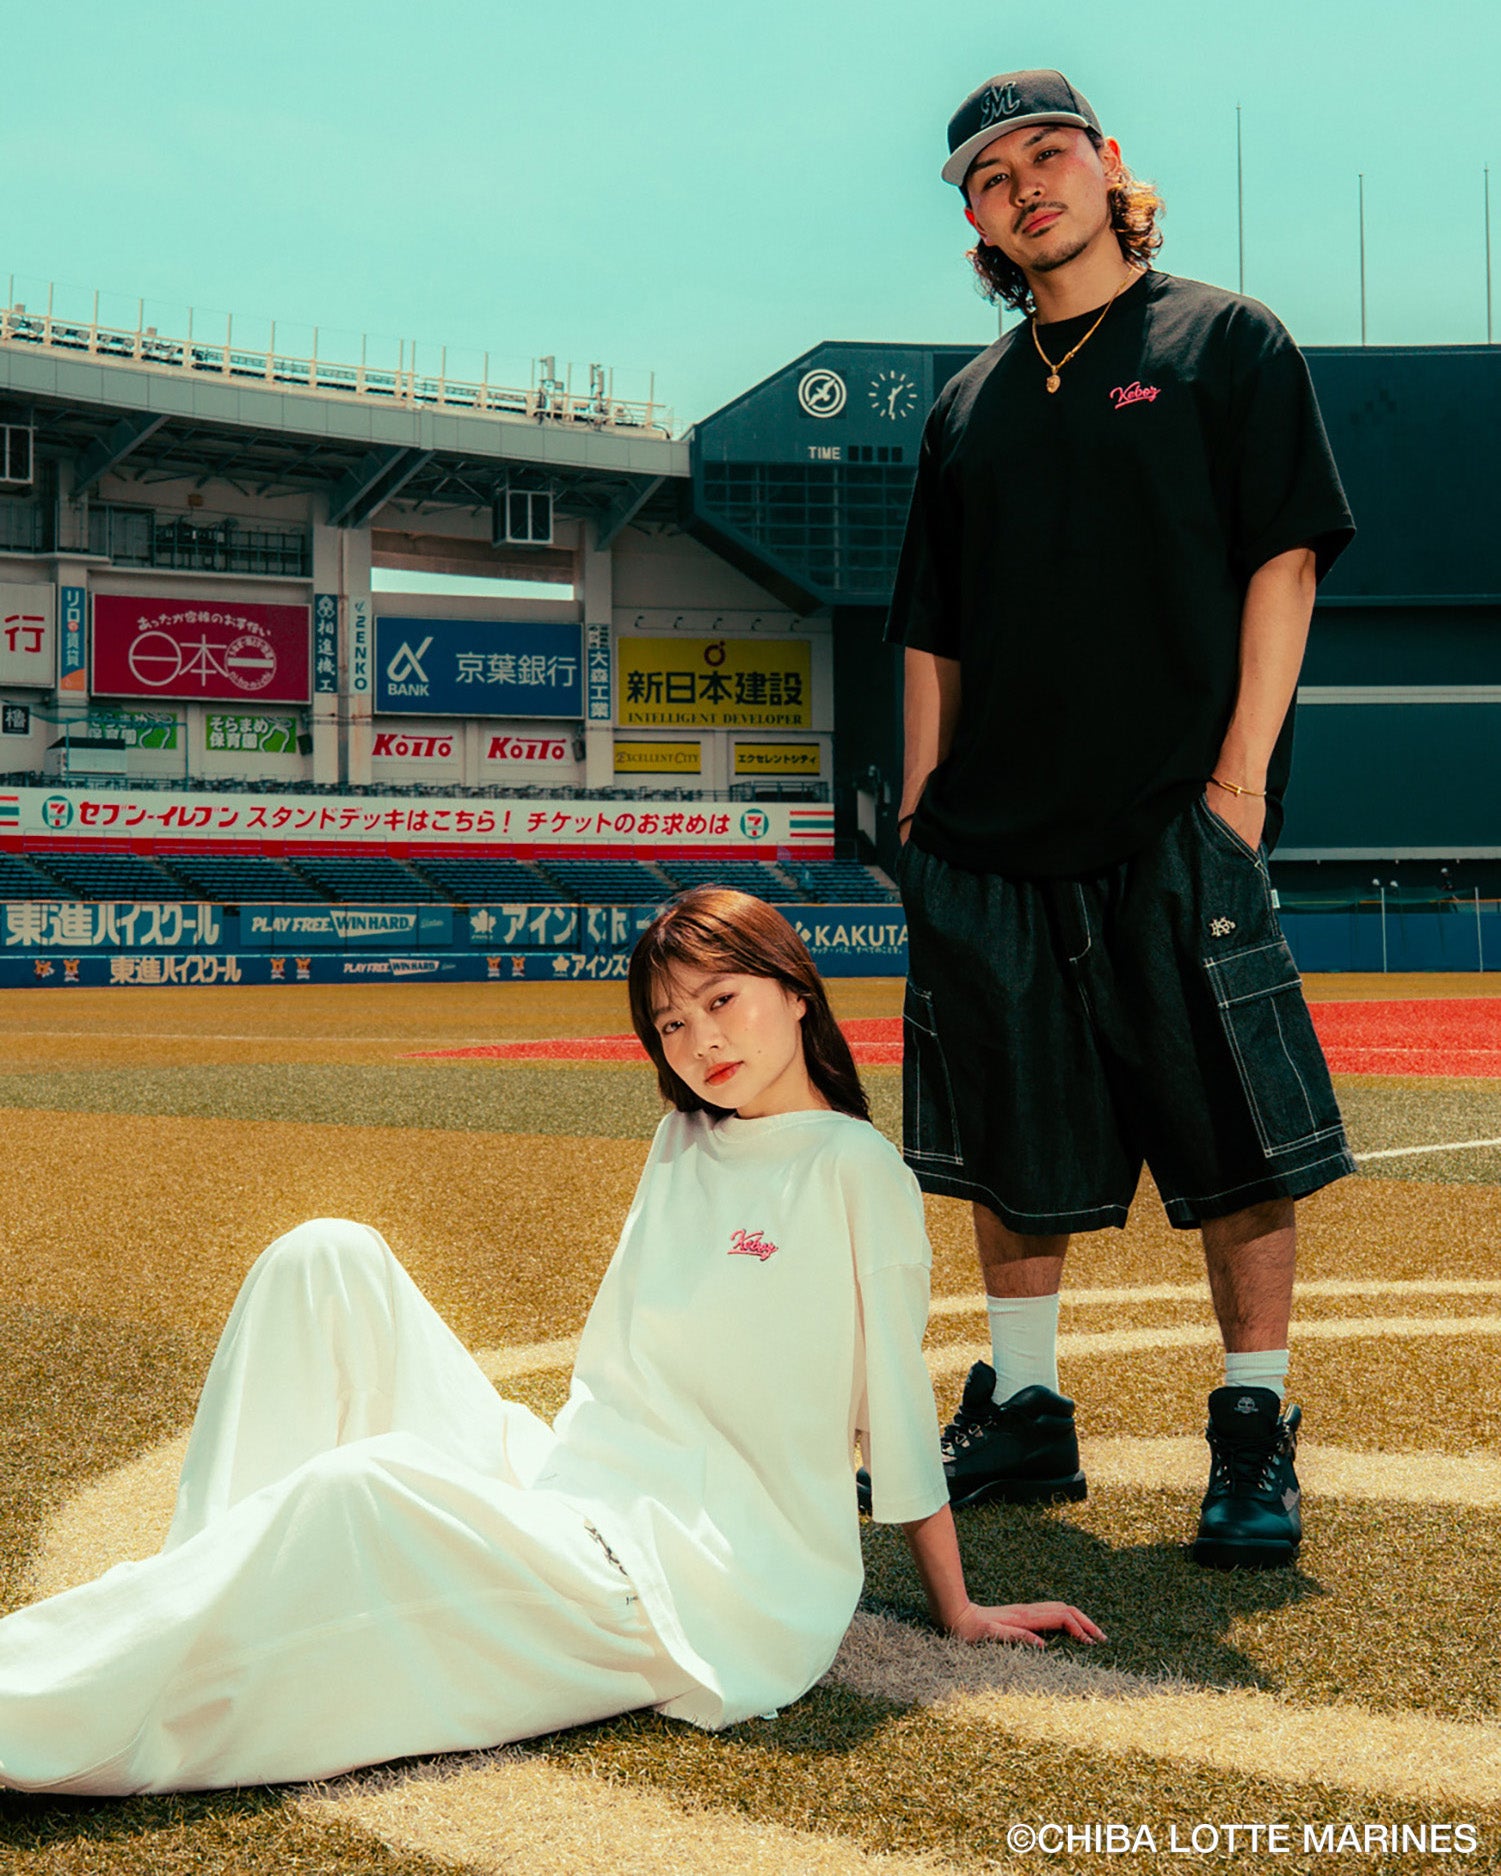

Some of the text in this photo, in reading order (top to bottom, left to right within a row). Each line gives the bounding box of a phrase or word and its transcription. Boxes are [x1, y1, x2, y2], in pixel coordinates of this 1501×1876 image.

[808, 446, 841, 460] TIME
[4, 615, 45, 653] 行
[456, 652, 577, 687] 京葉銀行
[388, 683, 430, 696] BANK
[627, 671, 803, 706] 新日本建設
[209, 716, 268, 733] そらまめ
[628, 712, 802, 725] INTELLIGENT DEVELOPER
[738, 754, 816, 765] エクセレントシティ
[527, 811, 731, 836] チケットのお求めは
[6, 903, 220, 946] 東進ハイスクール
[251, 916, 290, 932] PLAY
[336, 916, 367, 931] WIN
[110, 956, 242, 984] 東進ハイスクール
